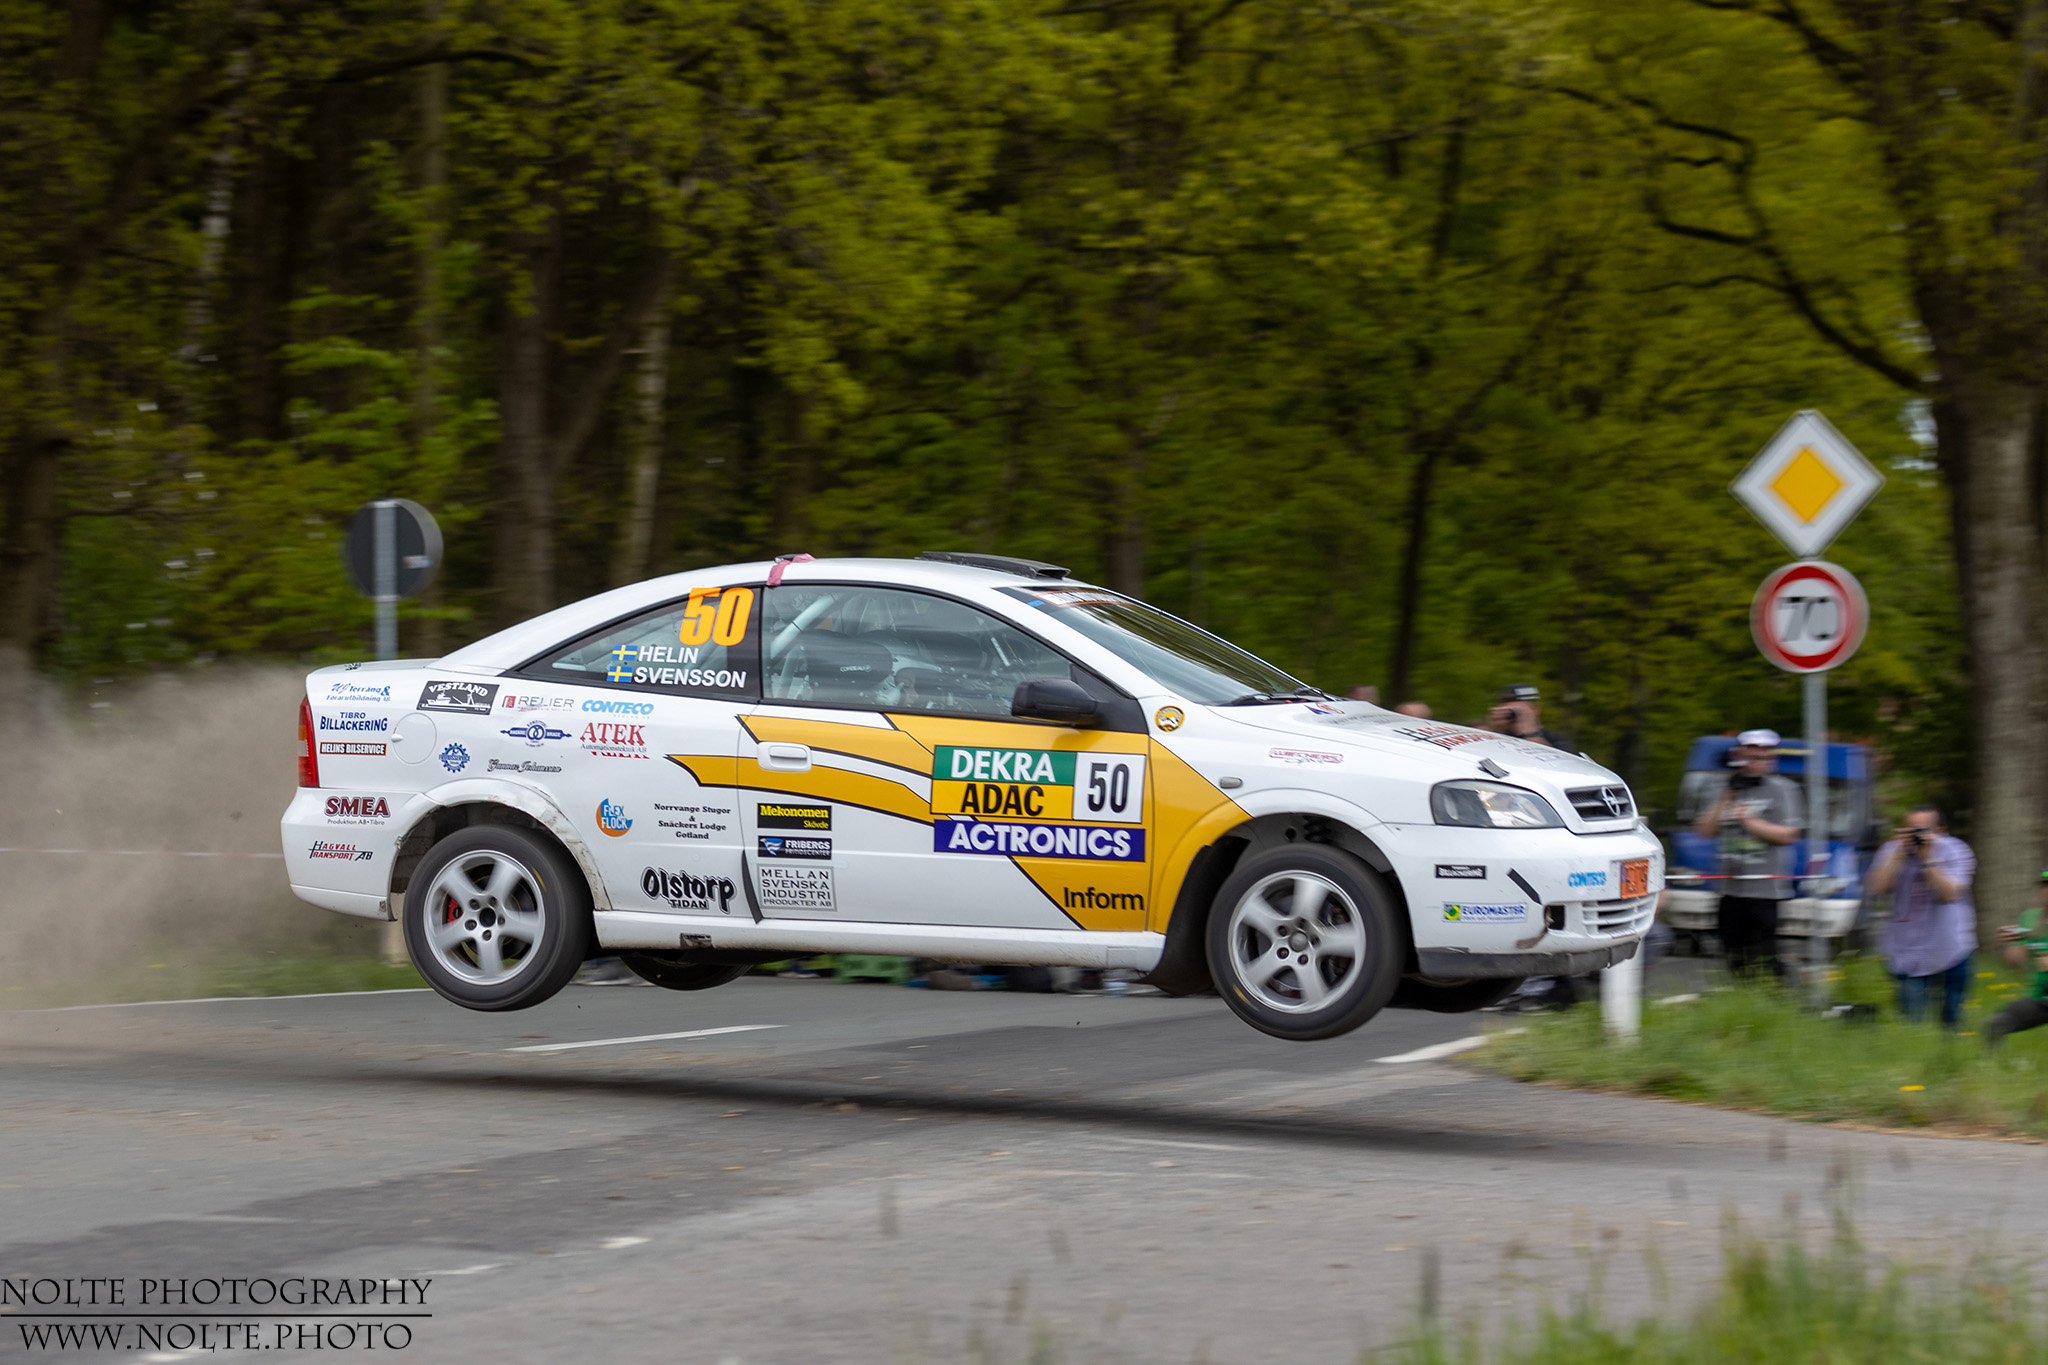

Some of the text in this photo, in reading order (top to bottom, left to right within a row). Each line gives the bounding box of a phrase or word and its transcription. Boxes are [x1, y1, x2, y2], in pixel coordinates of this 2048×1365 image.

[679, 587, 755, 646] 50
[1774, 597, 1839, 642] 70
[637, 647, 699, 664] HELIN
[633, 666, 747, 688] SVENSSON
[380, 685, 391, 696] &
[428, 682, 489, 697] VESTLAND
[517, 696, 575, 708] RELIER
[582, 699, 655, 715] CONTECO
[340, 711, 366, 719] TIBRO
[320, 715, 388, 731] BILLACKERING
[580, 722, 646, 746] ATEK
[321, 743, 385, 755] HELINS BILSERVICE
[950, 748, 1056, 783] DEKRA
[1088, 762, 1130, 814] 50
[960, 783, 1044, 816] ADAC
[325, 797, 390, 817] SMEA
[603, 804, 625, 817] FLEX
[654, 803, 731, 815] Norrvange Stugor
[760, 804, 829, 818] Mekonomen
[601, 817, 628, 829] FLOCK
[658, 820, 727, 831] Snäckers Lodge
[803, 820, 829, 829] Skövde
[675, 831, 709, 840] Gotland
[948, 823, 1132, 858] ACTRONICS
[312, 841, 357, 851] HAGVALL
[785, 840, 830, 850] FRIBERGS
[355, 851, 373, 861] AB
[761, 868, 829, 879] MELLAN
[642, 867, 736, 913] Olstorp
[762, 879, 830, 890] SVENSKA
[763, 889, 831, 900] INDUSTRI
[1063, 887, 1144, 911] Inform
[669, 899, 708, 909] TIDAN
[763, 898, 817, 906] PRODUKTER
